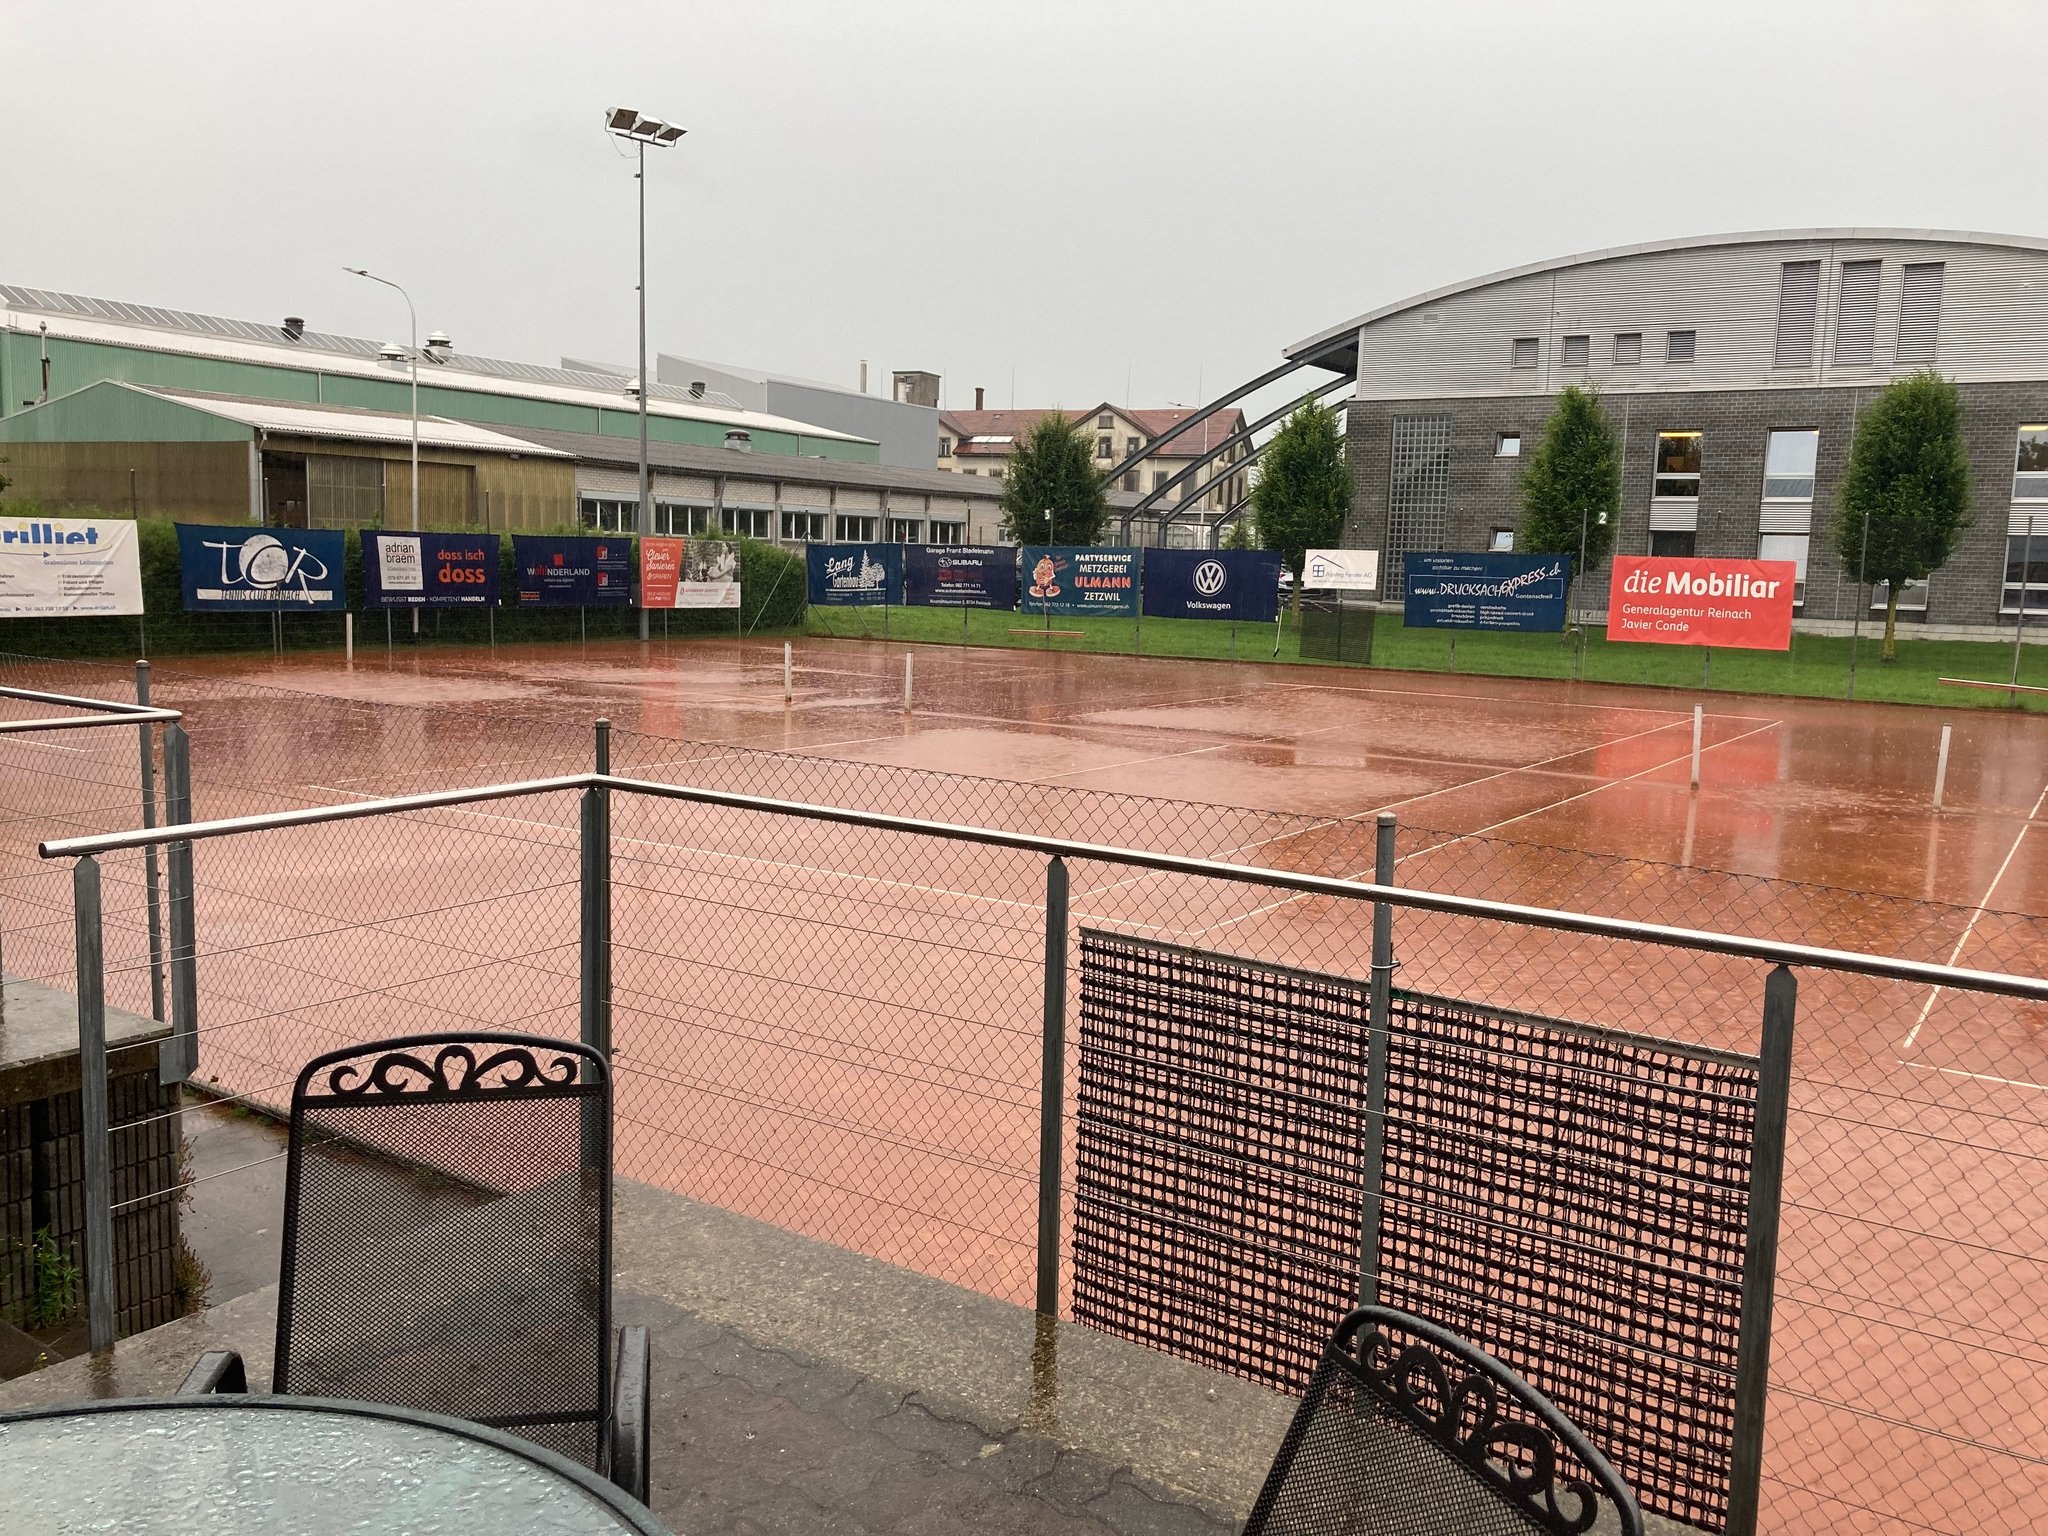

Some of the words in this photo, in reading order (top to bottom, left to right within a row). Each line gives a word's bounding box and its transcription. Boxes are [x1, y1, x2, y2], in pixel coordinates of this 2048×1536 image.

[1045, 509, 1050, 520] 3
[1599, 511, 1607, 524] 2
[0, 522, 99, 545] rilliet
[385, 542, 415, 553] adrian
[926, 547, 946, 555] Garage
[386, 553, 416, 564] braem
[437, 548, 462, 560] doss
[464, 548, 485, 560] isch
[646, 548, 671, 561] Clever
[1074, 554, 1132, 562] PARTYSERVICE
[646, 560, 676, 572] Sanieren
[824, 556, 855, 574] Lang
[1079, 564, 1127, 574] METZGEREI
[438, 562, 486, 584] doss
[832, 571, 859, 588] Gartenbau
[1074, 576, 1132, 588] ULMANN
[1623, 569, 1662, 594] die
[1665, 572, 1780, 599] Mobiliar
[221, 589, 247, 601] TENNIS
[249, 589, 268, 601] CLUB
[1084, 592, 1121, 601] ZETZWIL
[1186, 601, 1232, 610] Volkswagen
[1622, 604, 1705, 617] Generalagentur
[1708, 608, 1752, 620] Reinach
[1621, 618, 1652, 630] Javier
[1655, 620, 1689, 632] Conde
